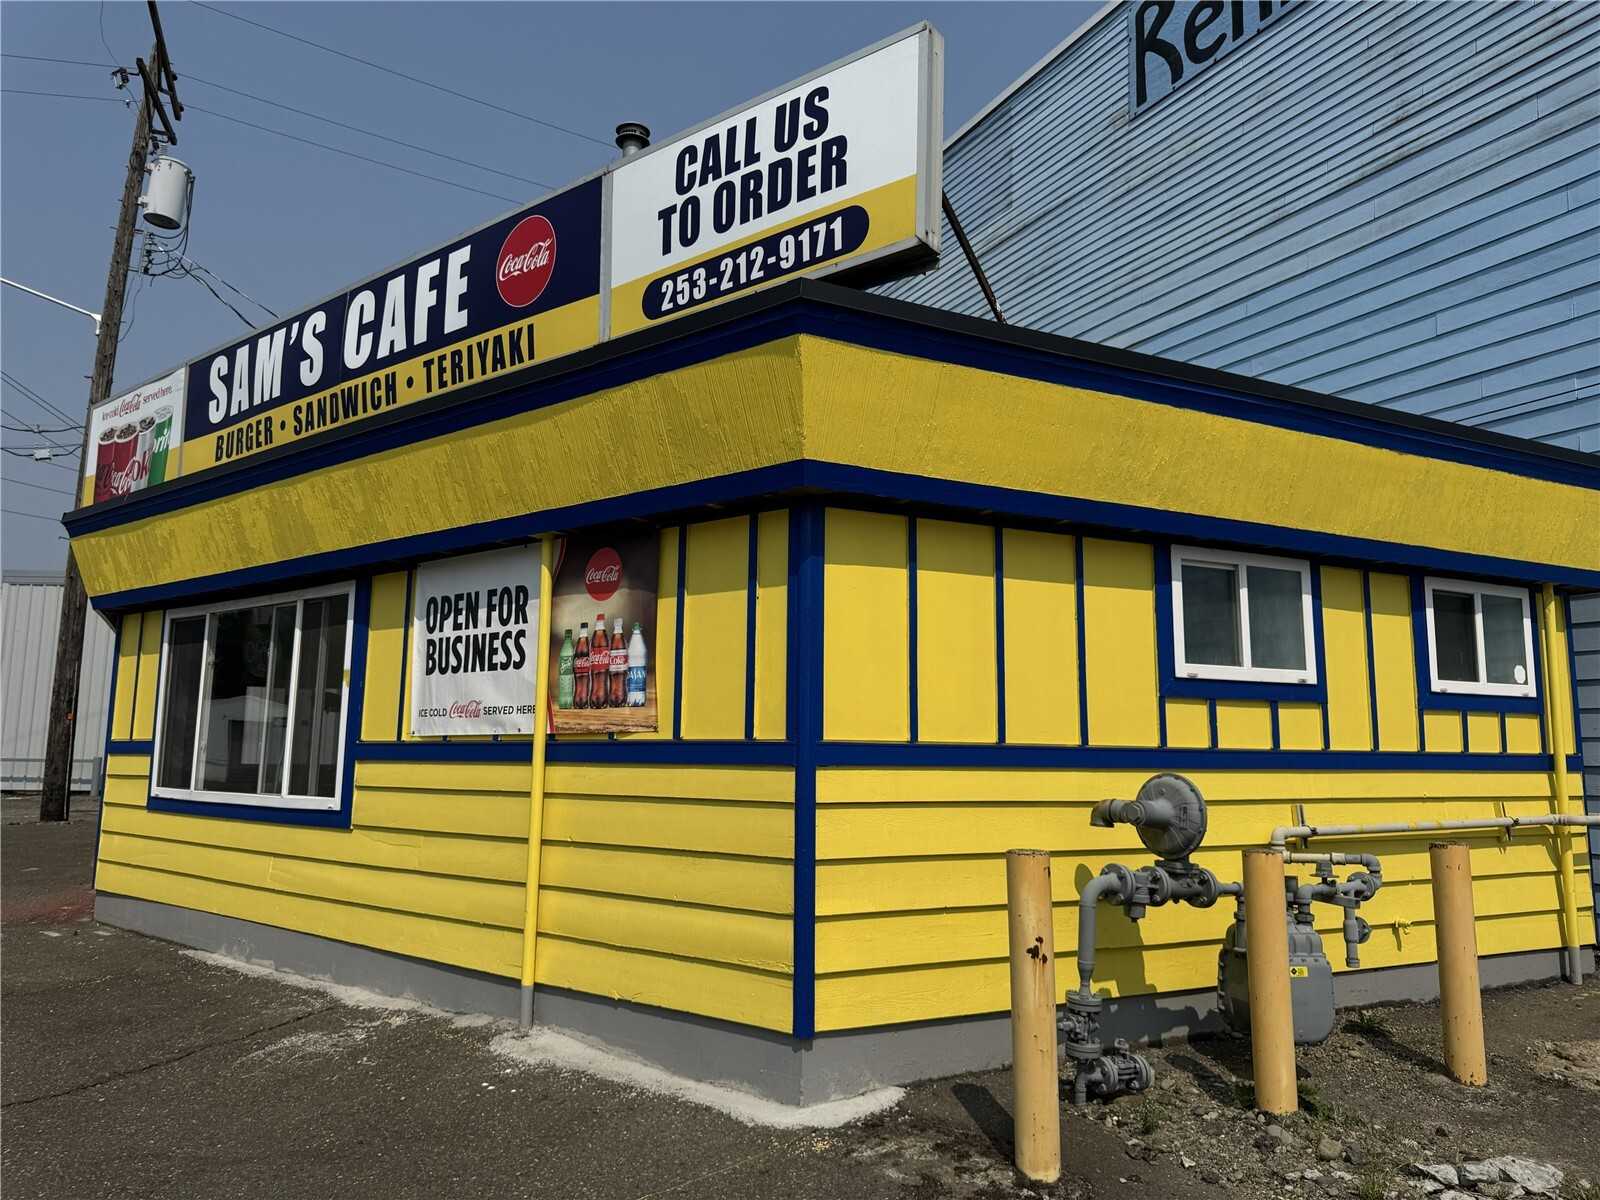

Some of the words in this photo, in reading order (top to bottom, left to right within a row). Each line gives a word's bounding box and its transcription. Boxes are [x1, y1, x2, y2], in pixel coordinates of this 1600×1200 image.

[675, 116, 761, 196] CALL
[774, 86, 830, 153] US
[657, 195, 701, 257] TO
[713, 134, 848, 235] ORDER
[499, 237, 553, 281] Coca-Cola
[661, 216, 843, 312] 253-212-9171
[208, 310, 327, 425] SAM'S
[343, 245, 471, 370] CAFE
[215, 414, 273, 463] BURGER
[292, 371, 397, 436] SANDWICH
[423, 323, 536, 394] TERIYAKI
[425, 591, 480, 635] OPEN
[486, 584, 529, 628] FOR
[585, 565, 620, 584] Coca-Cola
[425, 628, 528, 676] BUSINESS
[418, 708, 428, 718] ICE
[429, 707, 448, 717] COLD
[483, 705, 514, 715] SERVED
